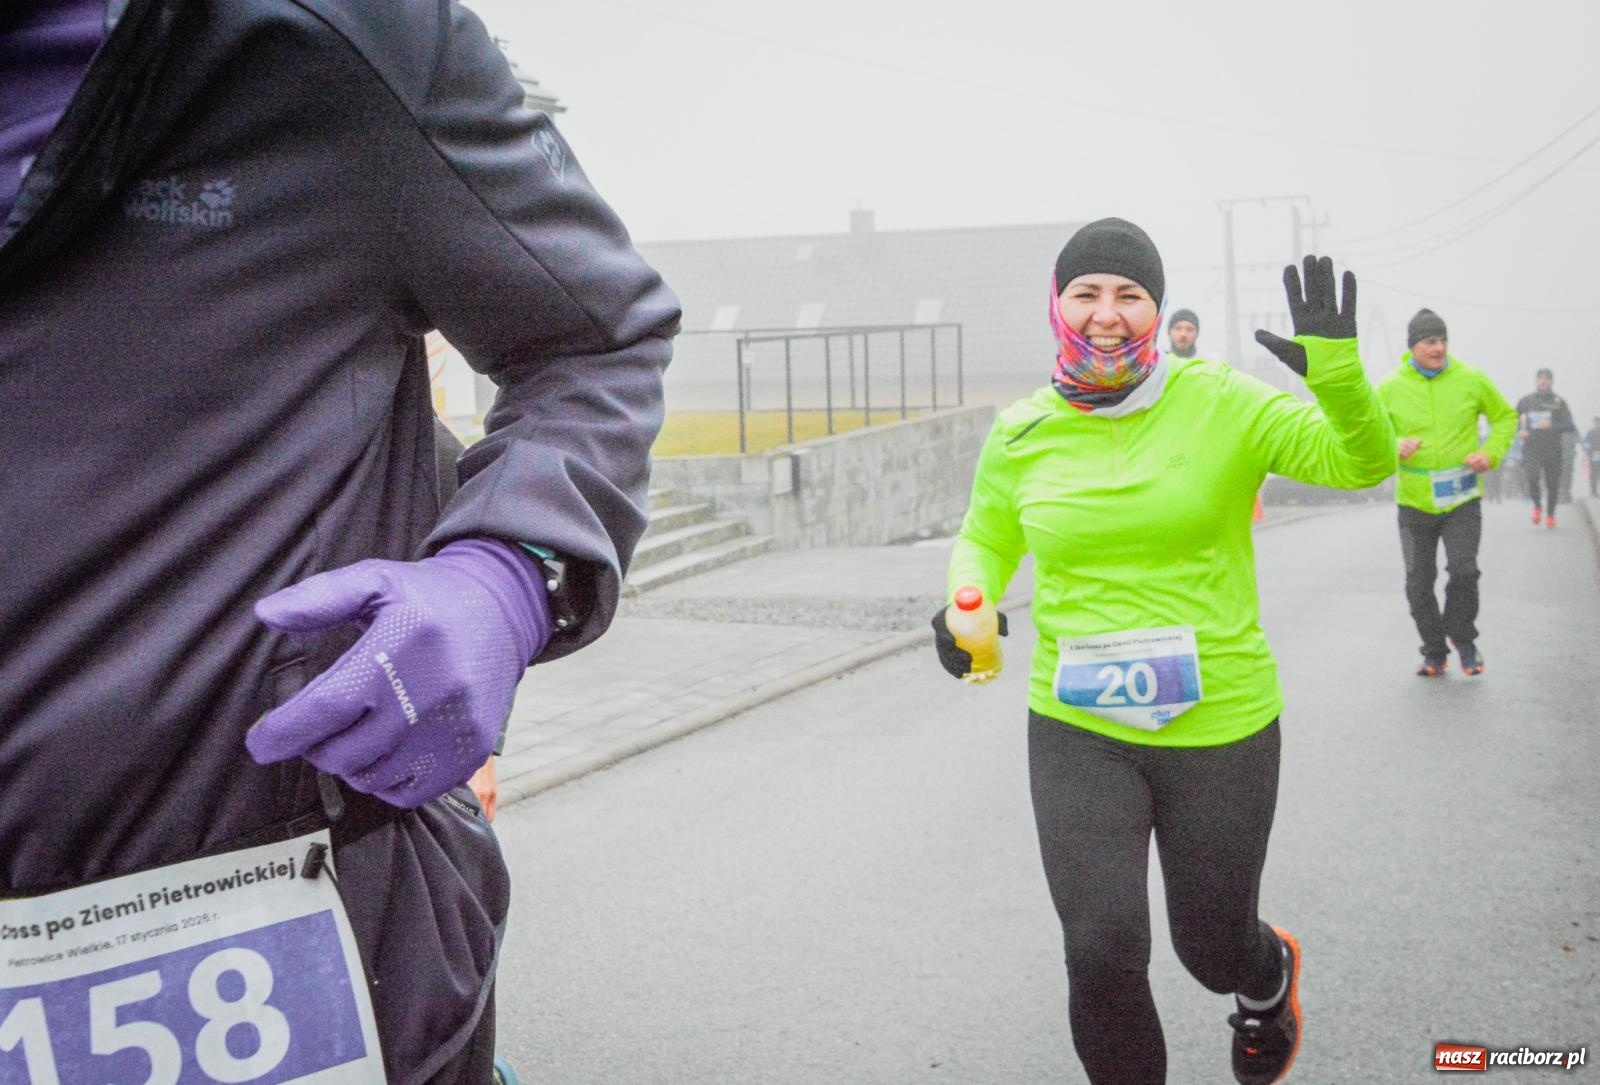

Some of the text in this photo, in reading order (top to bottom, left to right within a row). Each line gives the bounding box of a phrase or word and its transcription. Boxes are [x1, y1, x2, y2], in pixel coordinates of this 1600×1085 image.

[138, 176, 187, 200] ack
[1096, 662, 1158, 705] 20
[45, 917, 75, 940] po
[79, 894, 145, 926] Ziemi
[149, 858, 296, 909] Pietrowickiej
[115, 934, 126, 945] 17
[0, 947, 290, 1085] 158
